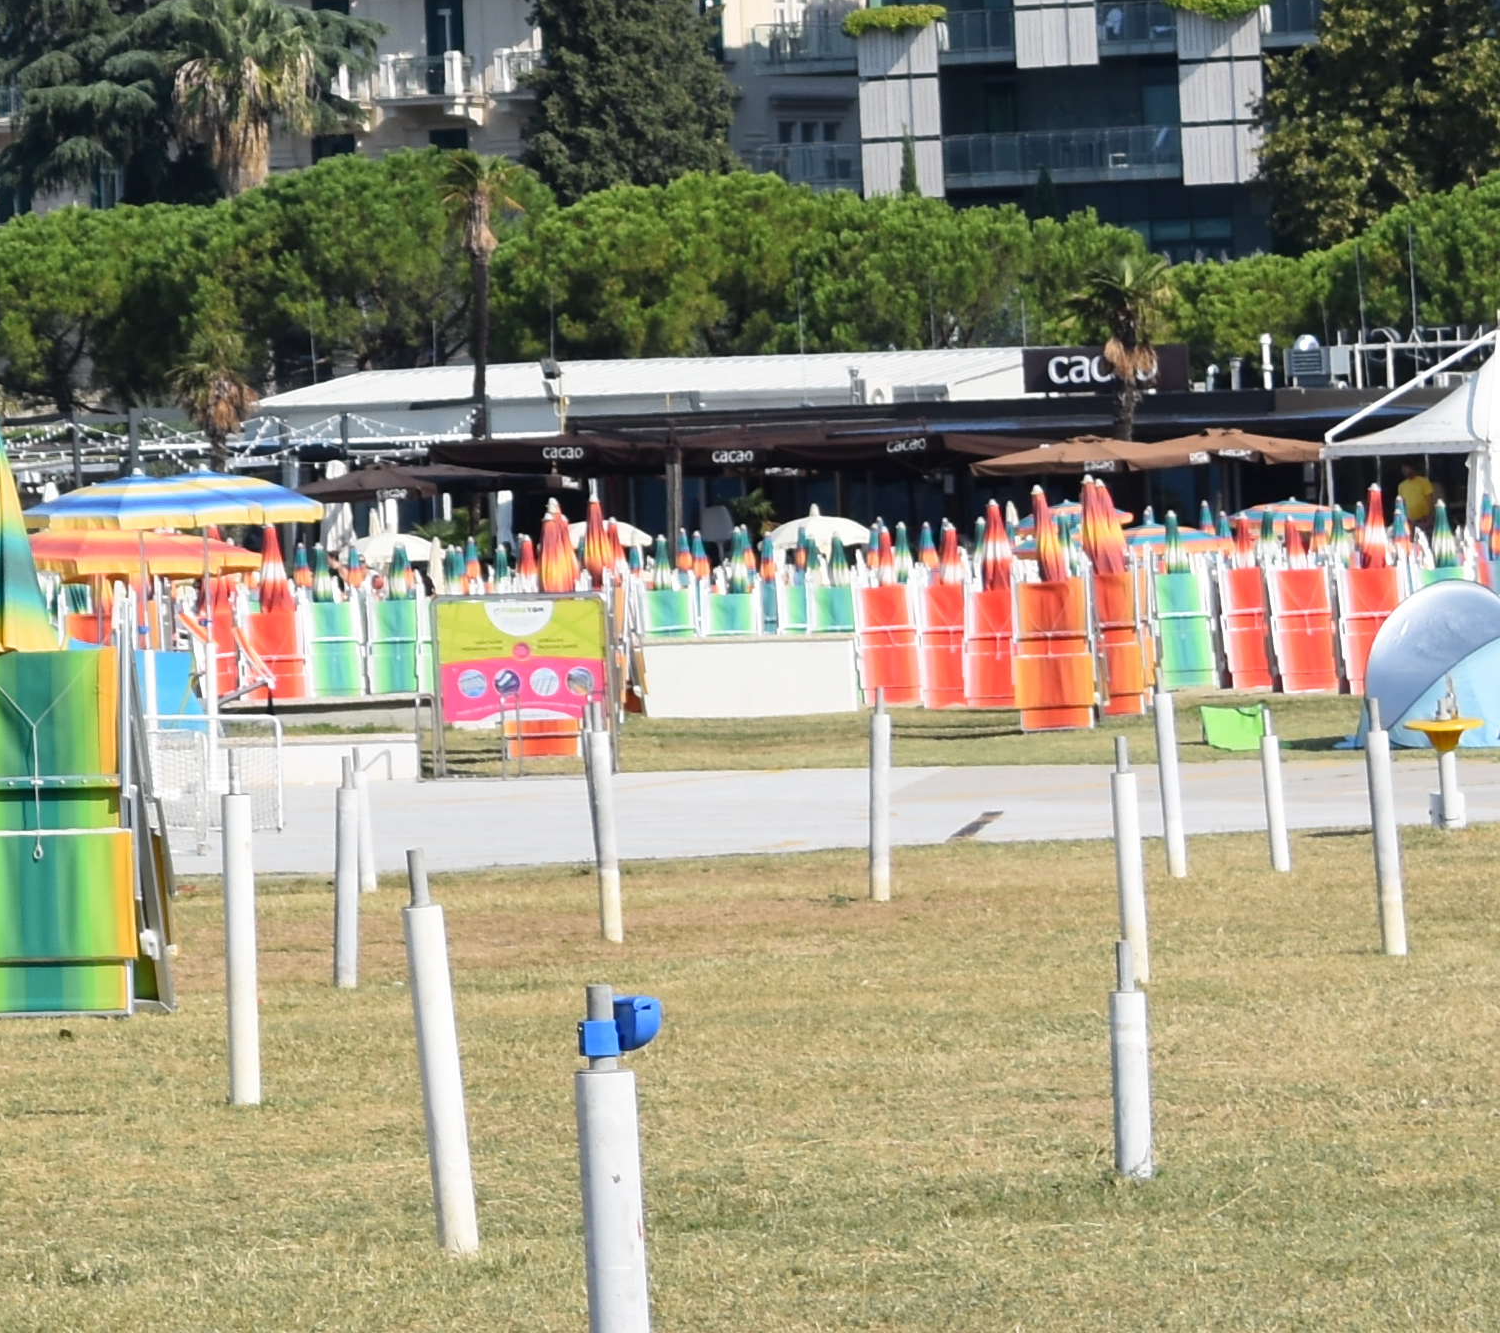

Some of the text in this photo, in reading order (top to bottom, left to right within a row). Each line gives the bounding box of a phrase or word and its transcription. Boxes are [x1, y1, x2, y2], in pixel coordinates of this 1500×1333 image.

[886, 437, 927, 453] cacao
[542, 446, 584, 460] cacao
[712, 450, 754, 464] cacao
